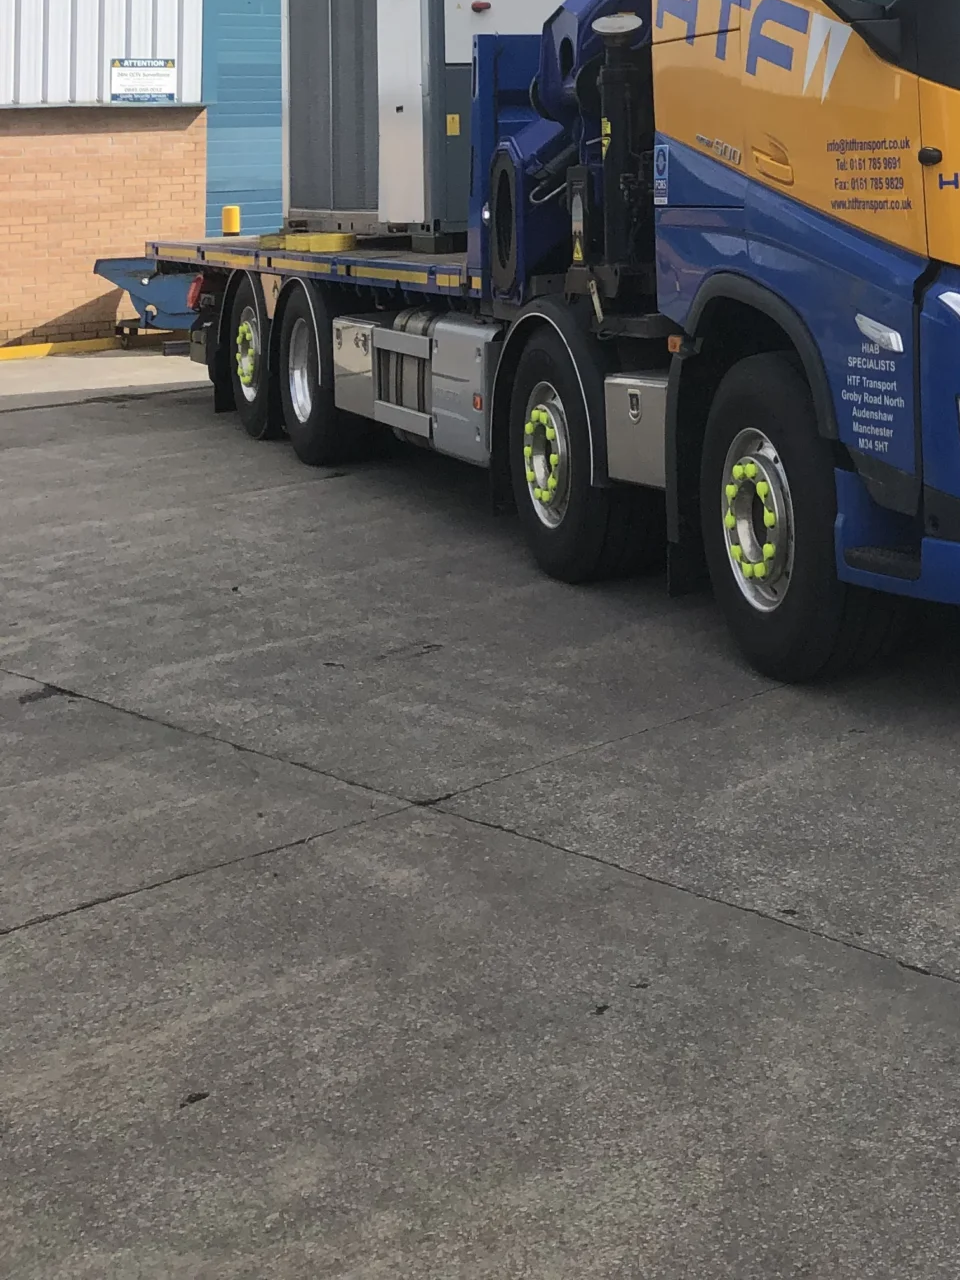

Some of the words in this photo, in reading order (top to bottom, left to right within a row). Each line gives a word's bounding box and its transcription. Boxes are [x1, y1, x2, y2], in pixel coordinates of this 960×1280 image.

[713, 138, 741, 166] 500
[827, 136, 910, 154] info@htftransport.co.uk
[836, 158, 848, 171] Tel:
[850, 158, 866, 170] 0161
[868, 157, 882, 170] 785
[655, 179, 667, 190] FORS
[834, 177, 849, 190] Fax:
[851, 177, 867, 190] 0161
[870, 177, 883, 190] 785
[831, 196, 912, 213] www.htftransport.co.uk
[861, 342, 880, 355] HIAB
[847, 356, 896, 372] SPECIALISTS
[846, 375, 861, 387] HTF
[862, 376, 897, 391] Transport
[841, 389, 862, 404] Groby
[863, 392, 882, 405] Road
[883, 396, 905, 408] North
[852, 406, 894, 422] Audenshaw
[852, 422, 894, 437] Manchester
[858, 437, 873, 450] M34
[874, 439, 889, 453] 5HT
